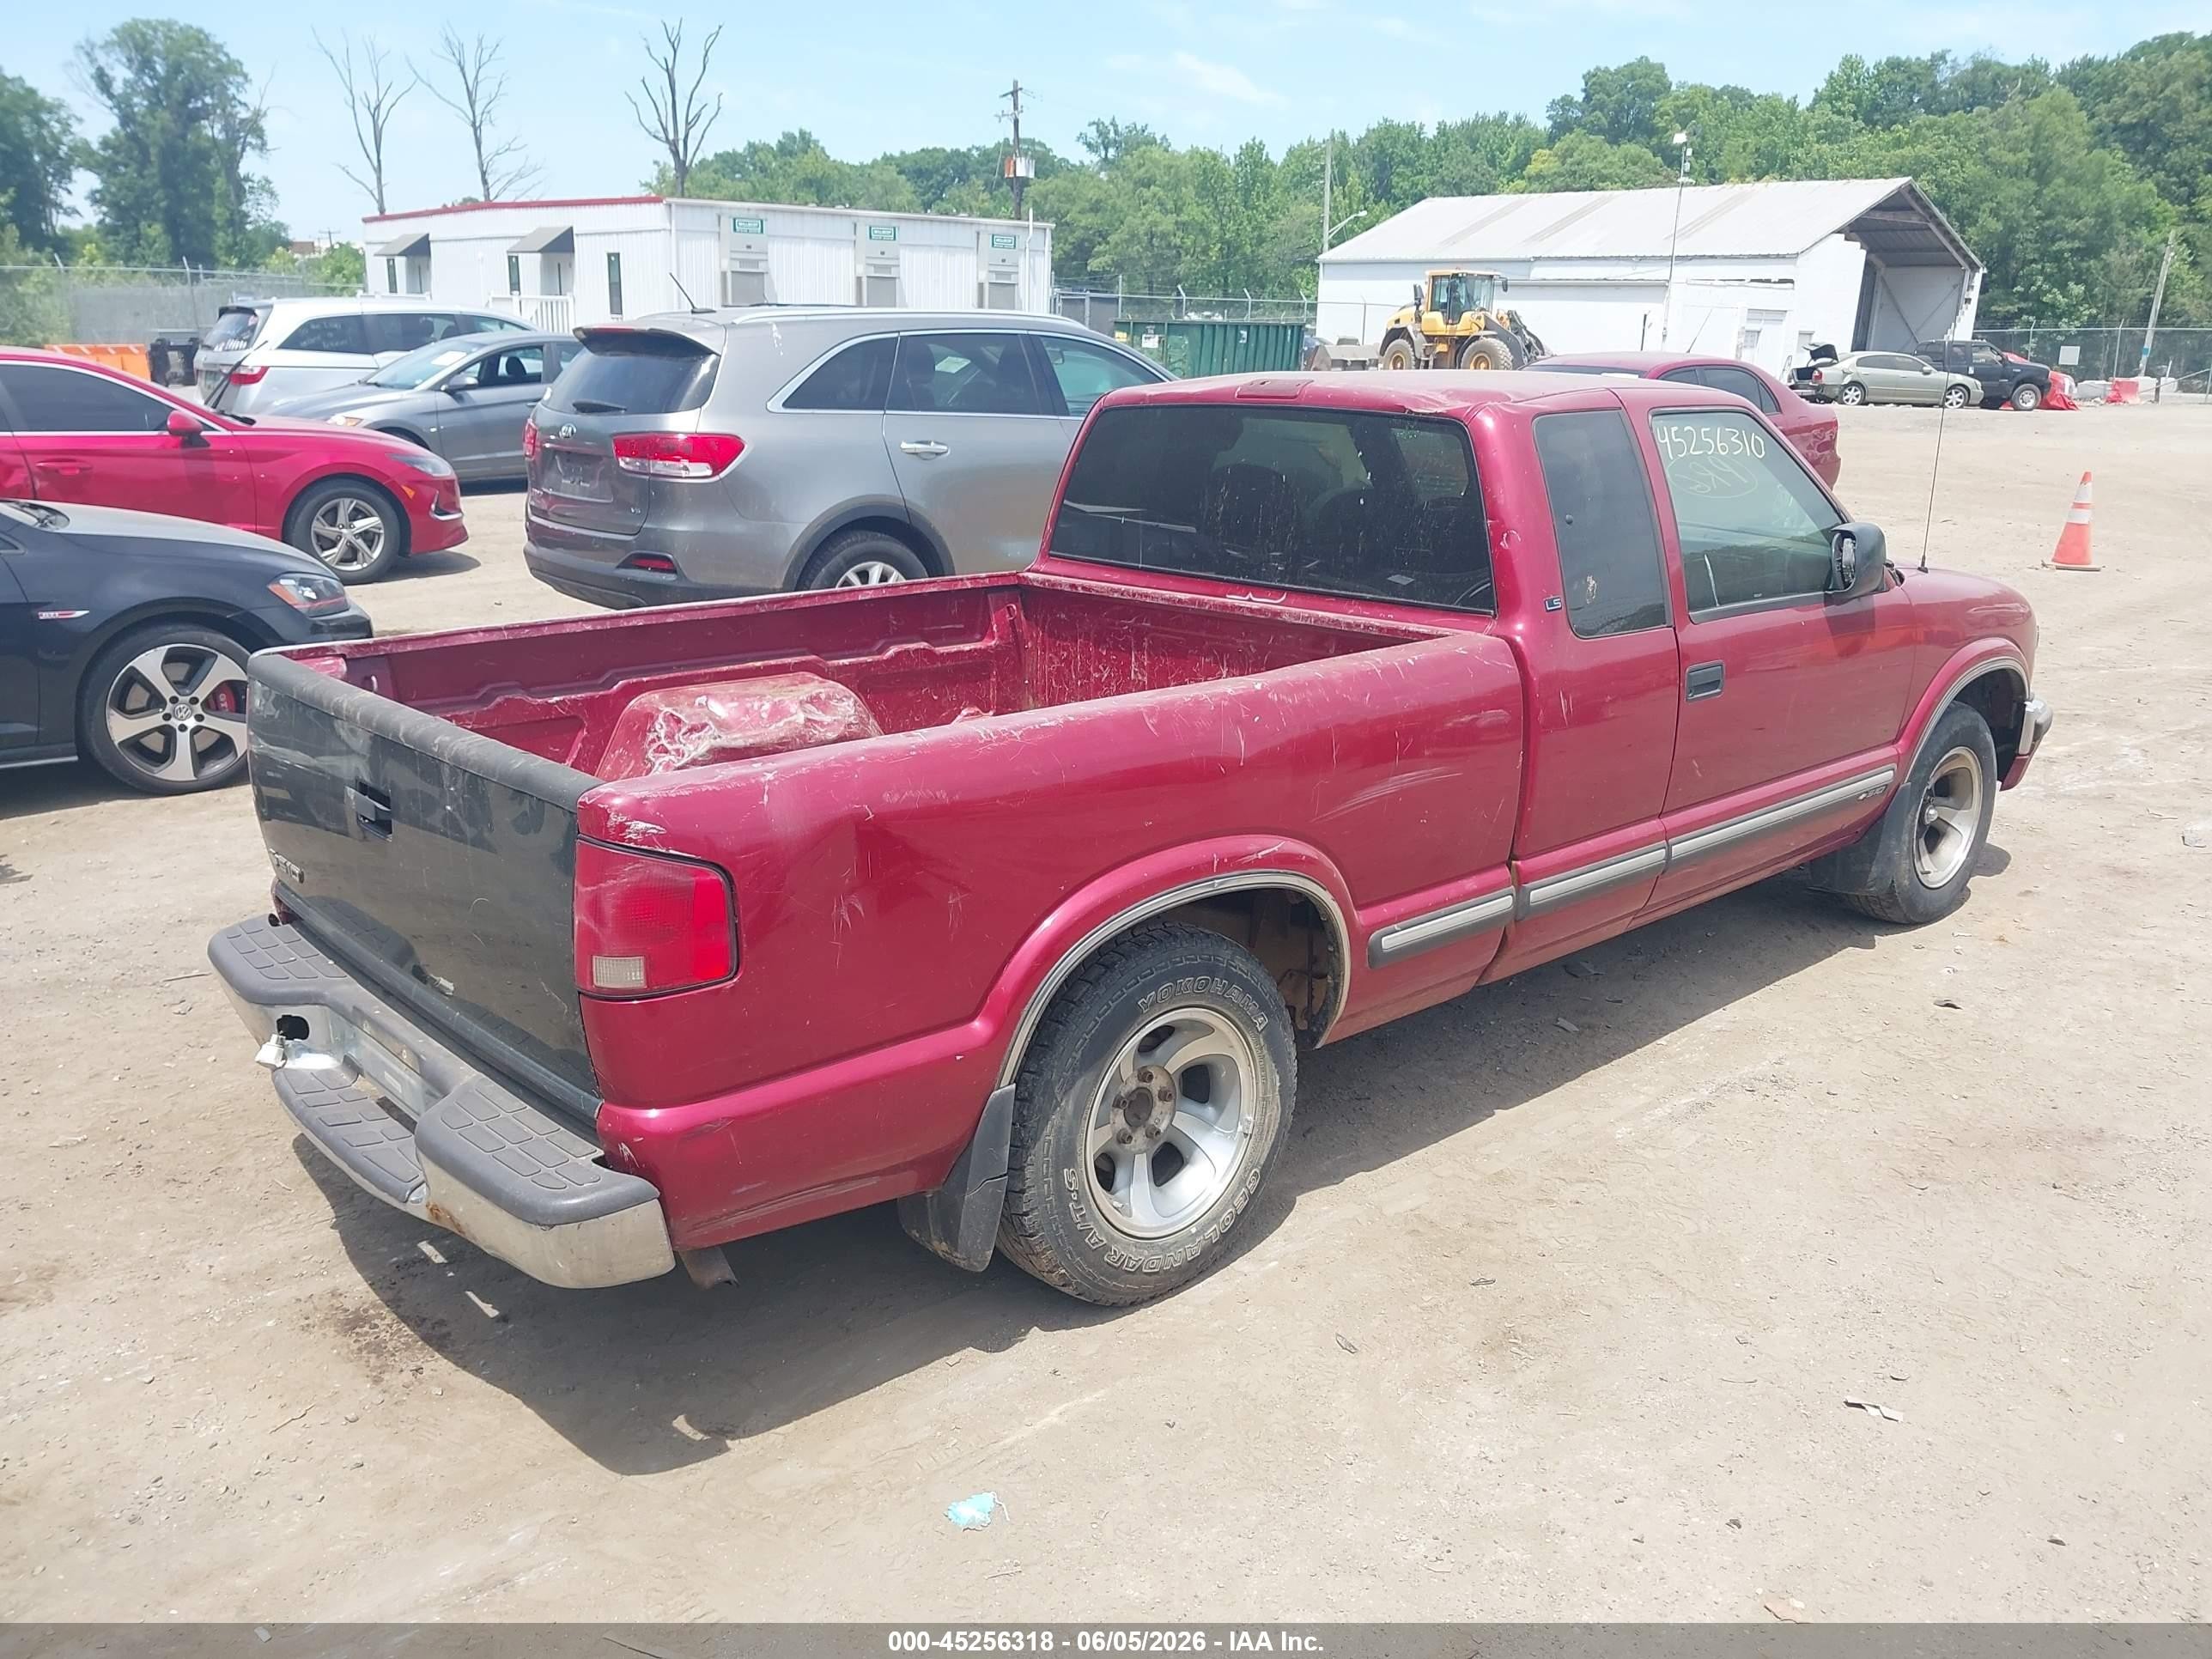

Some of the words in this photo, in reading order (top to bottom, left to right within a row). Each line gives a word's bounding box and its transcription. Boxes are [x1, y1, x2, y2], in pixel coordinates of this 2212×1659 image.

[1656, 426, 1765, 459] 45256310
[1545, 598, 1562, 611] LS
[1136, 975, 1269, 1032] YOKOHAMA
[1104, 1168, 1261, 1273] GEOLANDAR
